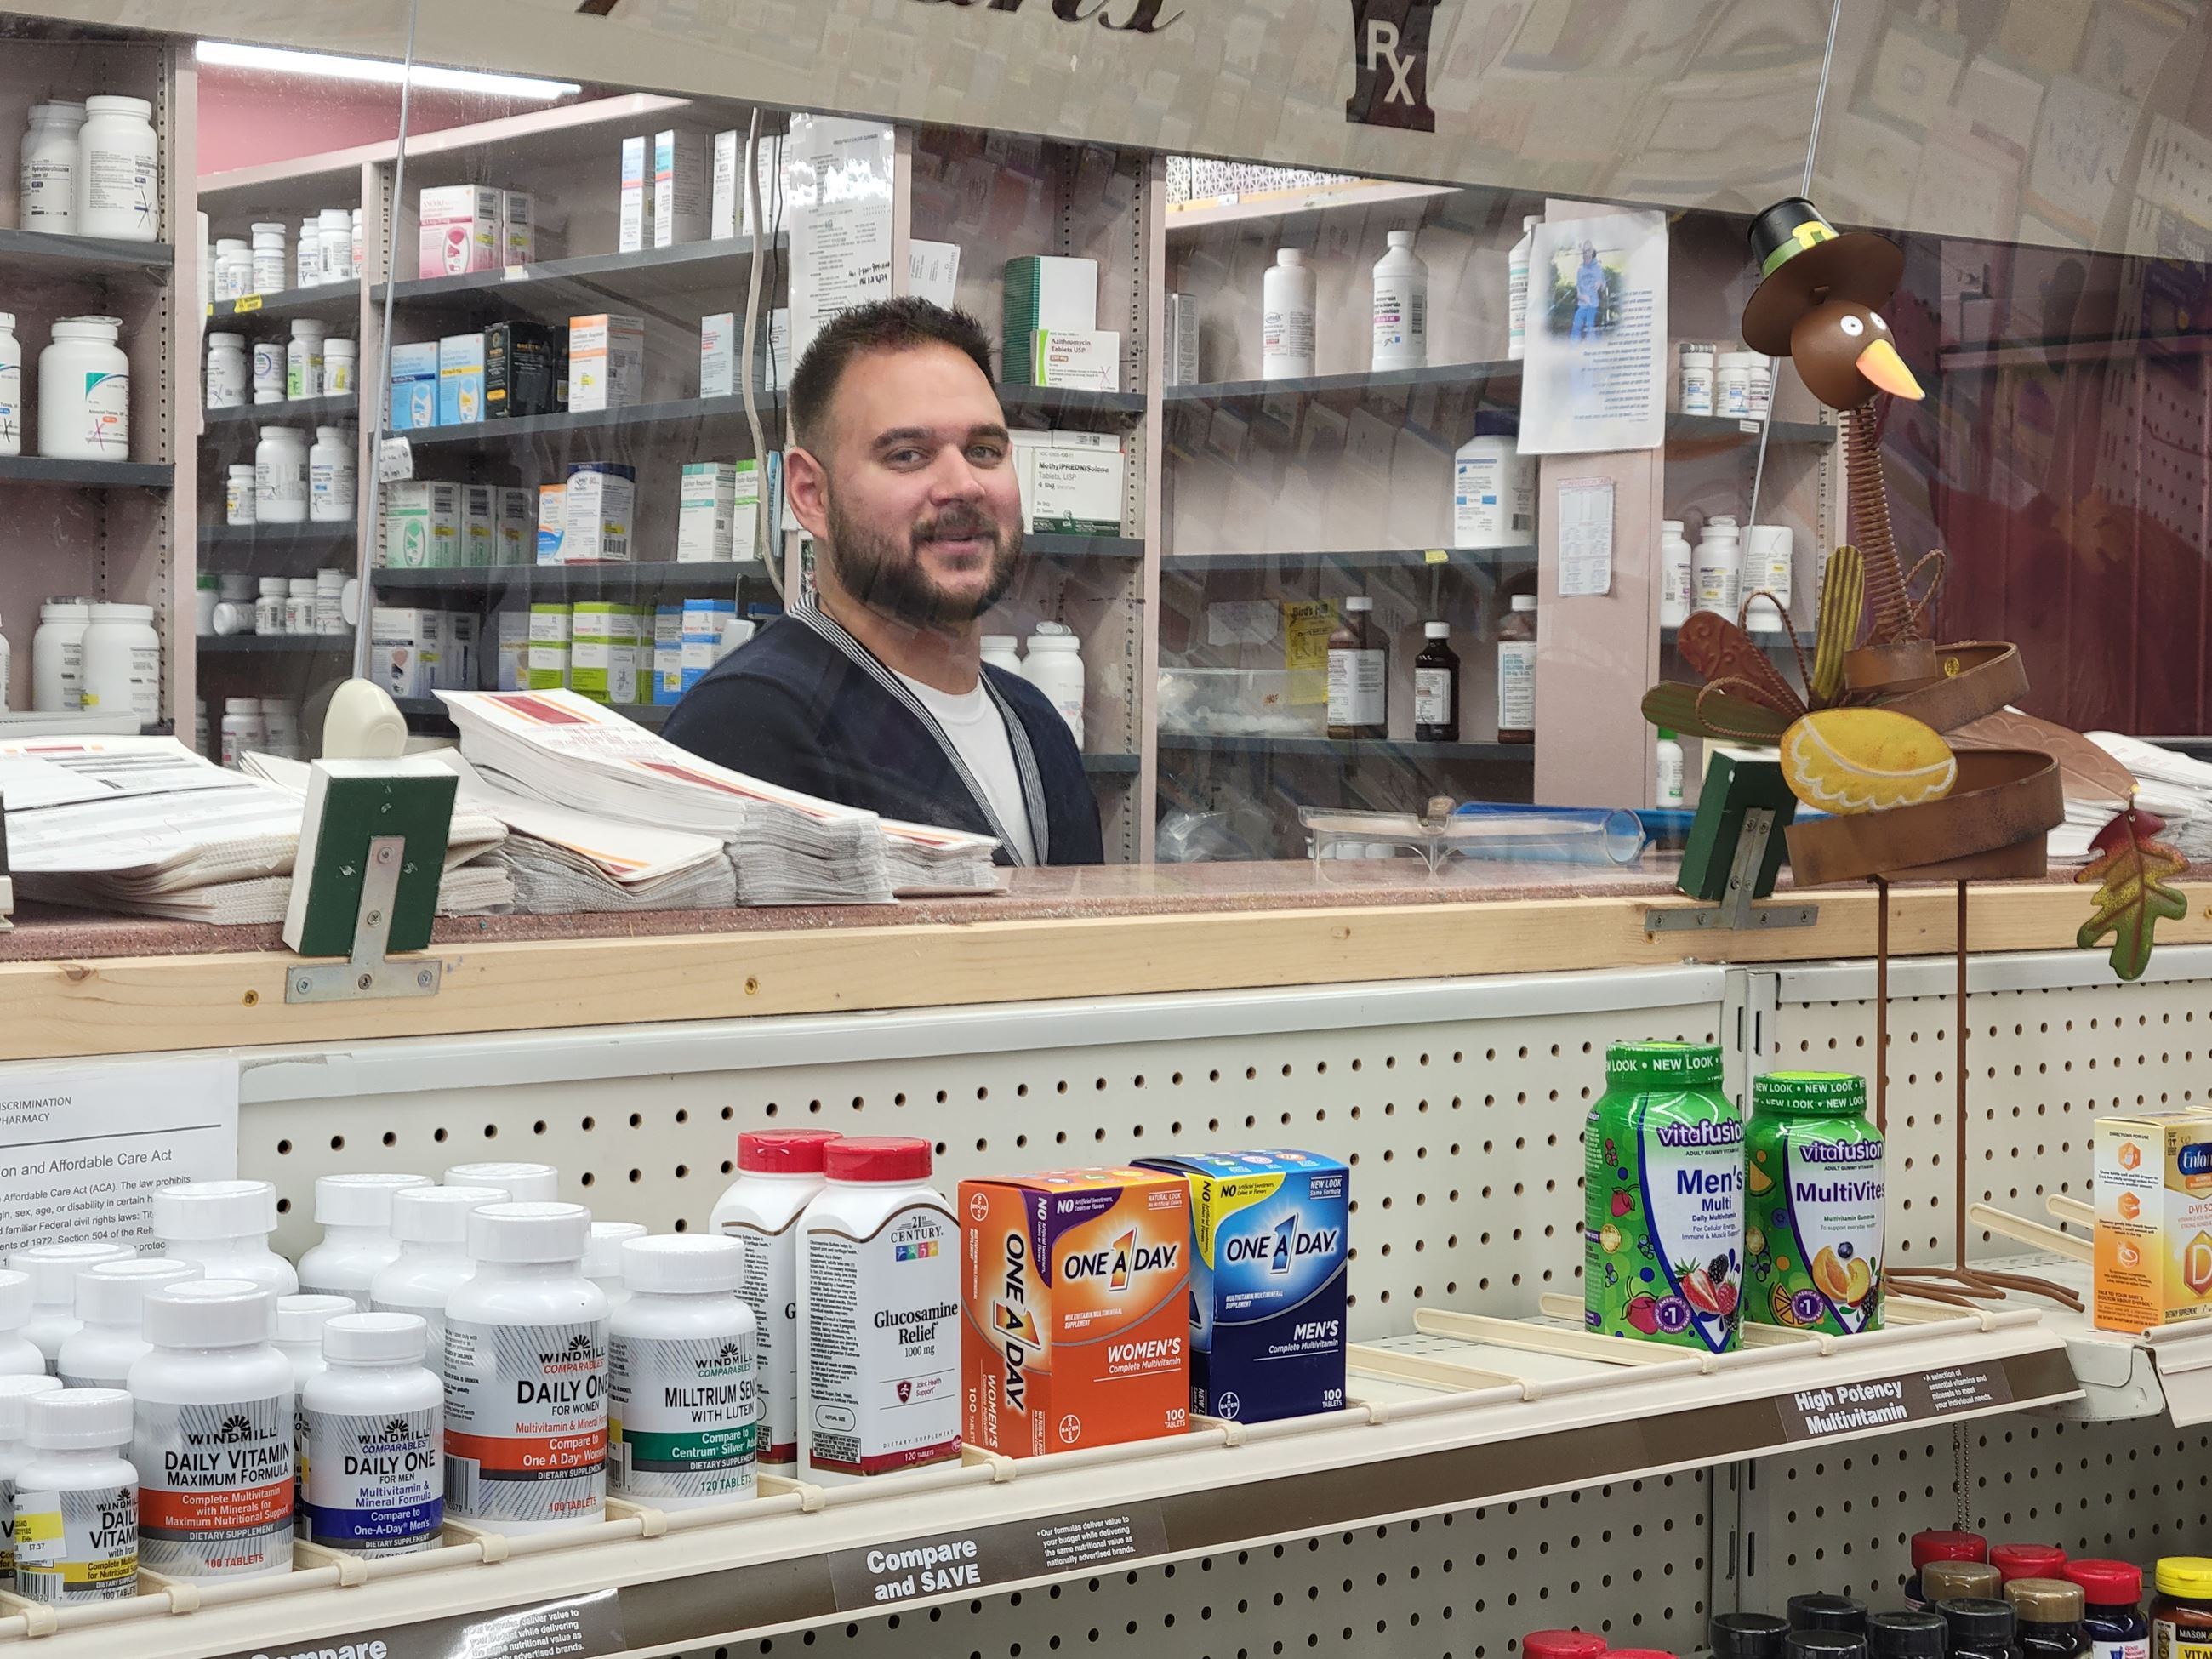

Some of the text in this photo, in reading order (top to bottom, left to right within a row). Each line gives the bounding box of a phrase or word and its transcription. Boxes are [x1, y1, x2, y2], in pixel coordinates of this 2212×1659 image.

[1653, 1058, 1682, 1070] NEW
[1686, 1056, 1713, 1069] LOOK
[1770, 1084, 1793, 1092] LOOK
[1805, 1084, 1827, 1092] NEW
[1831, 1081, 1853, 1092] LOOK
[1801, 1140, 1883, 1160] vitafusion
[21, 1149, 172, 1175] and Affordable Care Act
[1677, 1165, 1742, 1194] Men's
[4, 1190, 48, 1202] Affordable
[50, 1188, 71, 1198] Care
[73, 1186, 87, 1194] Act
[121, 1181, 136, 1190] The
[139, 1179, 153, 1188] law
[156, 1176, 191, 1188] prohibits
[1220, 1183, 1236, 1198] NO
[1796, 1181, 1884, 1202] MultiVites
[15, 1208, 33, 1218] sex,
[36, 1206, 54, 1217] age,
[67, 1198, 104, 1212] disability
[106, 1199, 114, 1207] in
[117, 1195, 145, 1206] certain
[1057, 1200, 1074, 1214] NO
[1702, 1196, 1731, 1211] Multi
[1227, 1237, 1271, 1261] ONE
[1274, 1234, 1288, 1257] A
[1006, 1234, 1024, 1304] ONE
[1065, 1252, 1109, 1279] ONE
[1112, 1251, 1126, 1274] A
[874, 1302, 958, 1328] Glucosamine
[1294, 1320, 1338, 1340] MEN'S
[905, 1345, 935, 1357] 1000 mg
[1108, 1337, 1181, 1363] WOMEN'S
[1269, 1338, 1338, 1354] Complete Multivitamin
[539, 1348, 606, 1364] WINDMILL
[696, 1354, 752, 1368] WINDMILL
[1109, 1357, 1181, 1373] Complete Multivitamin
[916, 1378, 942, 1388] Joint Health
[1929, 1374, 1987, 1391] essential vitamins and
[1930, 1371, 1953, 1381] selection
[517, 1379, 581, 1404] DAILY
[665, 1385, 737, 1408] MILLTRIUM
[1324, 1389, 1342, 1401] 100
[1794, 1380, 1903, 1411] High Potency
[1932, 1389, 1955, 1400] minerals
[1963, 1386, 1975, 1394] meet
[552, 1402, 600, 1416] FOR WOMEN
[987, 1374, 997, 1448] WOMEN'S
[1322, 1400, 1342, 1409] TABLETS
[1935, 1394, 1993, 1411] your individual needs.
[692, 1410, 722, 1422] WITH
[1166, 1408, 1185, 1420] 100
[1805, 1404, 1908, 1435] Multivitamin
[1165, 1419, 1185, 1428] TABLETS
[188, 1428, 276, 1445] WINDMILL
[358, 1429, 430, 1444] WINDMILL
[165, 1440, 289, 1471] DAILY VITAMIN
[345, 1450, 436, 1475] DAILY ONE
[905, 1451, 916, 1462] 120
[168, 1466, 288, 1487] MAXIMUM FORMULA
[379, 1474, 415, 1484] FOR MEN
[701, 1474, 752, 1491] 120 TABLETS
[182, 1486, 281, 1506] Complete Multivitamin
[359, 1484, 421, 1497] Multivitamin
[356, 1491, 431, 1508] Mineral Formula
[550, 1497, 596, 1512] 100 TABLETS
[166, 1504, 288, 1527] Maximum Nutritional Support
[196, 1502, 271, 1516] with Minerals for
[371, 1508, 420, 1522] Compare to
[1040, 1515, 1130, 1537] Our formulas deliver value to
[1042, 1525, 1131, 1548] your budget while delivering
[1045, 1548, 1056, 1557] the
[1057, 1545, 1074, 1555] same
[1075, 1539, 1107, 1553] nutritional
[1108, 1537, 1124, 1547] value
[204, 1553, 265, 1569] 100 TABLETS
[867, 1539, 978, 1574] Compare
[1046, 1546, 1136, 1569] nationally advertised brands.
[875, 1563, 981, 1601] and SAVE
[2180, 1629, 2207, 1639] MASON
